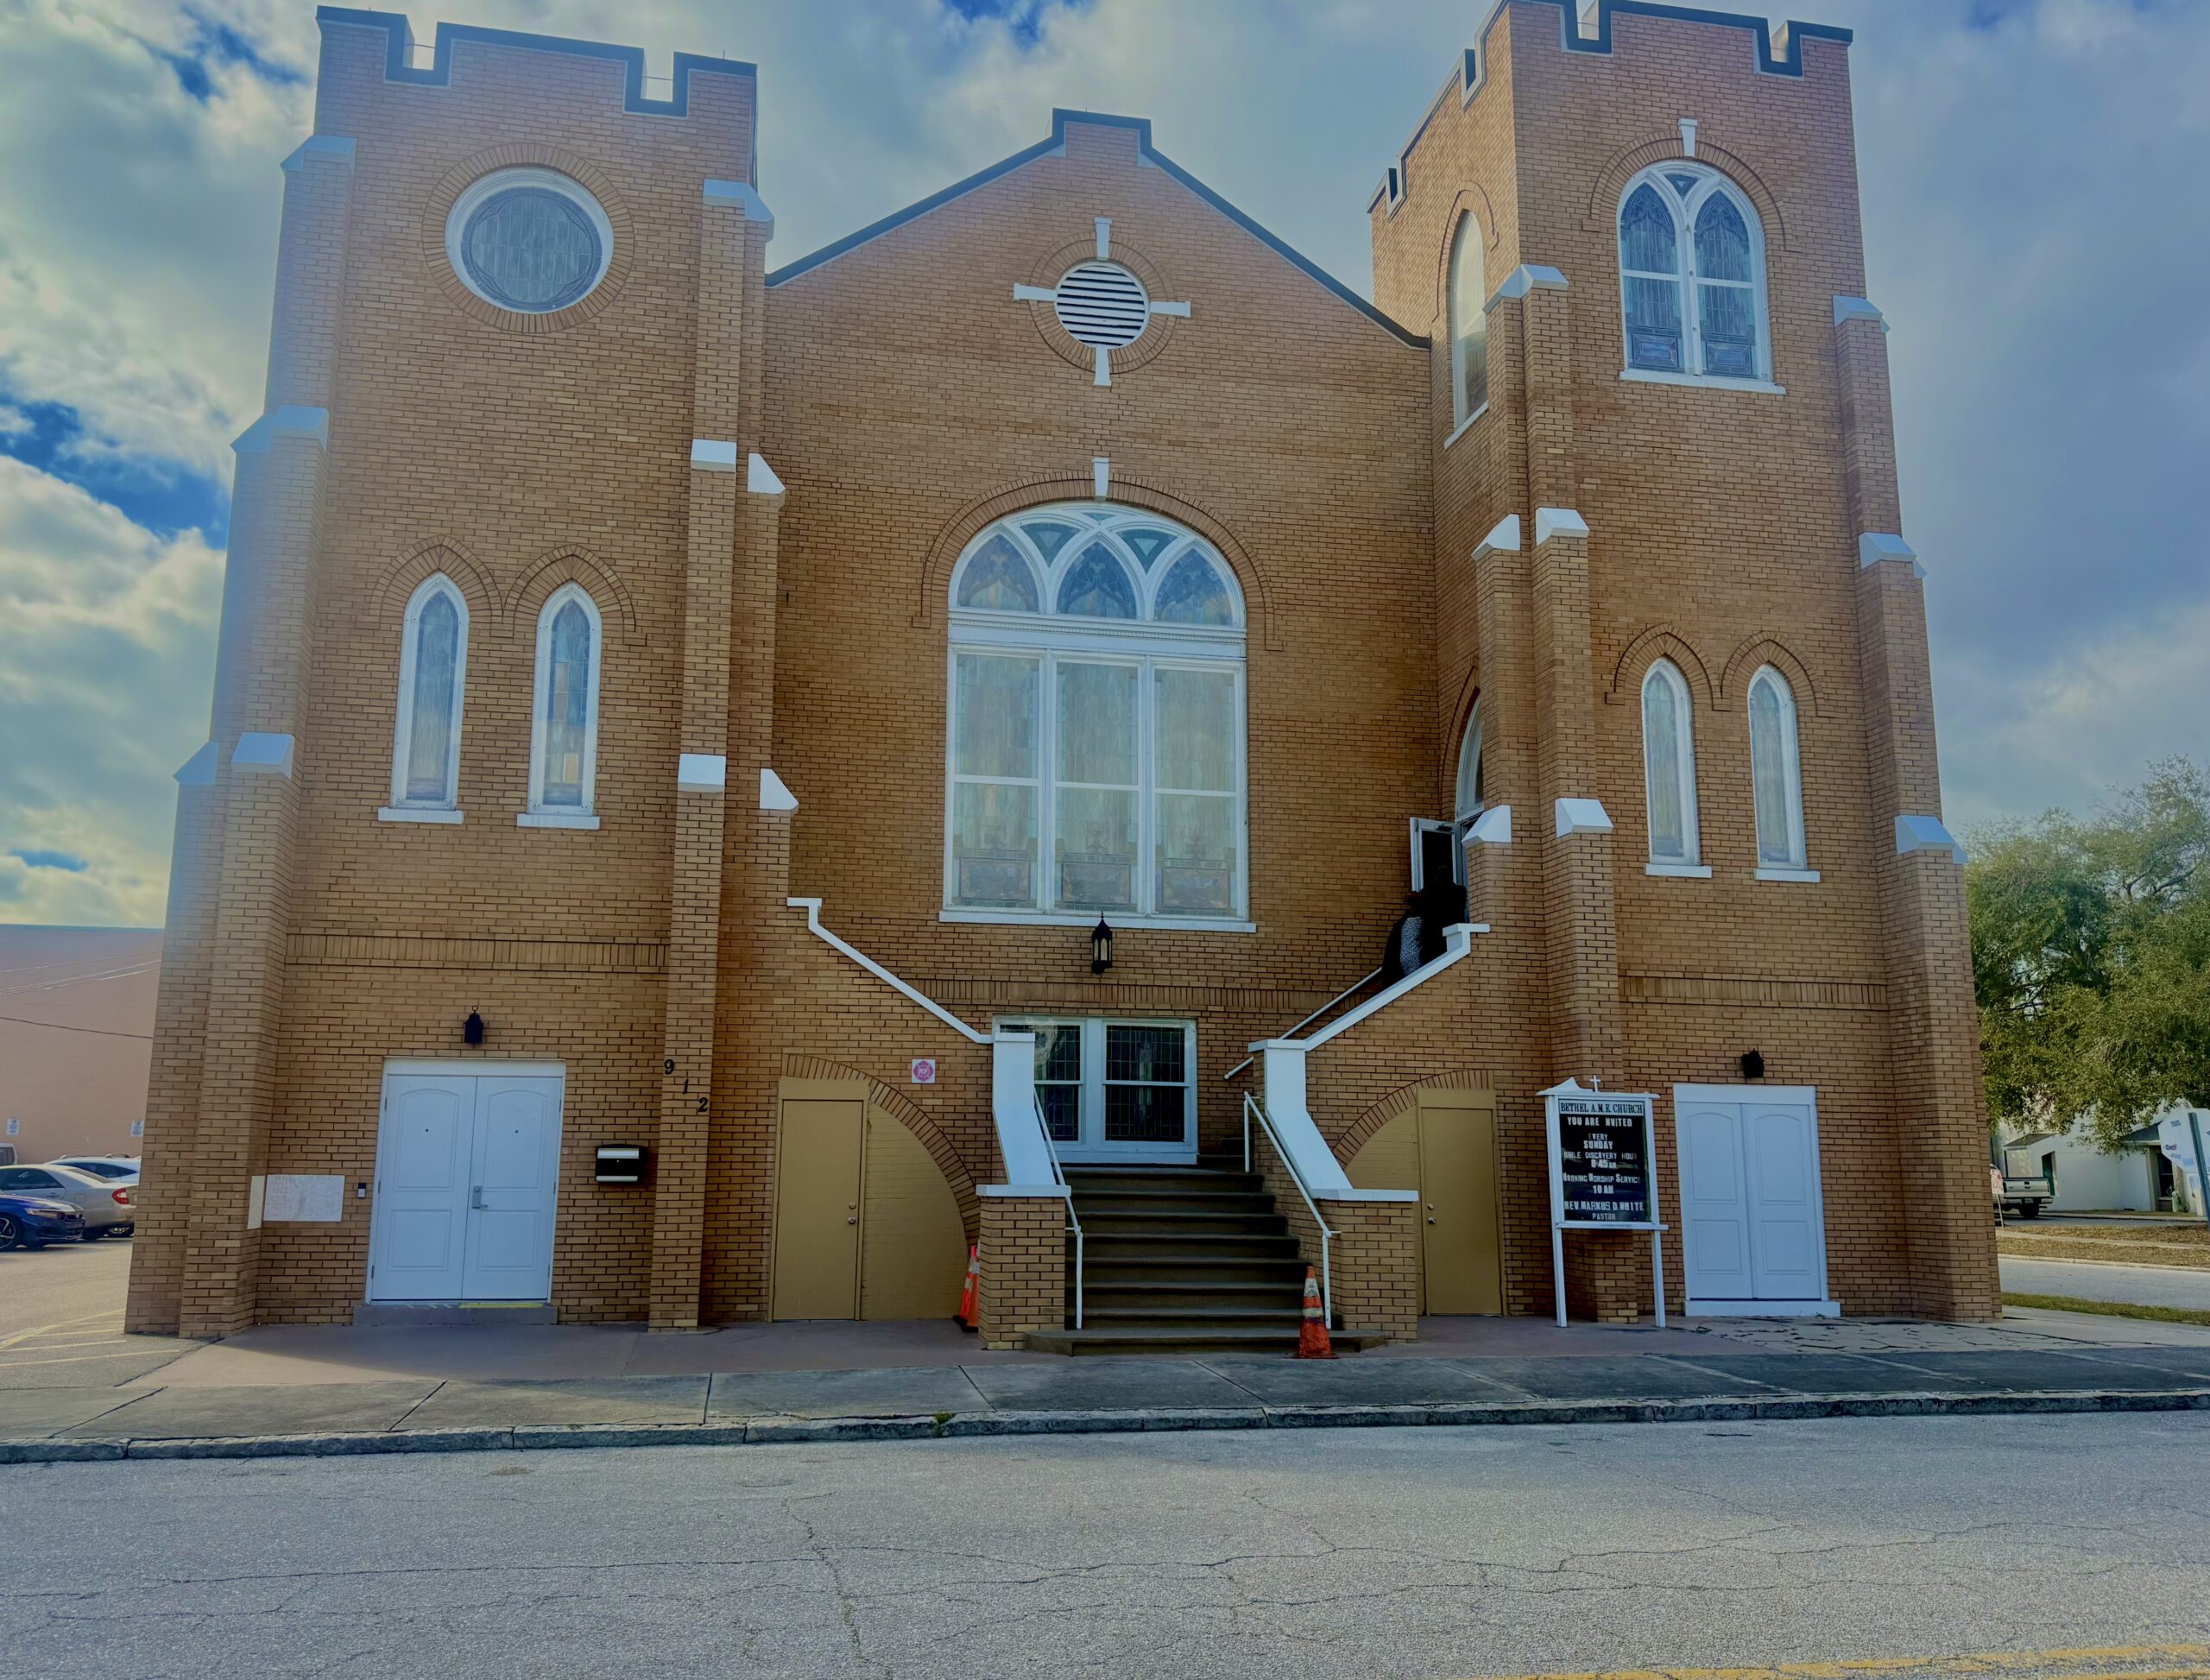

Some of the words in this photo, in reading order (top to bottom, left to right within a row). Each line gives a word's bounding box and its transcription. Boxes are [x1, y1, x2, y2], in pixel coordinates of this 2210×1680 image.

[1561, 1102, 1588, 1112] BETHEL
[1613, 1103, 1643, 1114] CHURCH
[1568, 1116, 1582, 1126] YOU
[1585, 1117, 1600, 1127] ARE
[1583, 1140, 1613, 1150] SUNDAY
[1563, 1151, 1582, 1159] BIBLE
[1593, 1184, 1602, 1194] 10
[1603, 1184, 1614, 1194] AM
[1619, 1201, 1644, 1211] WHITE
